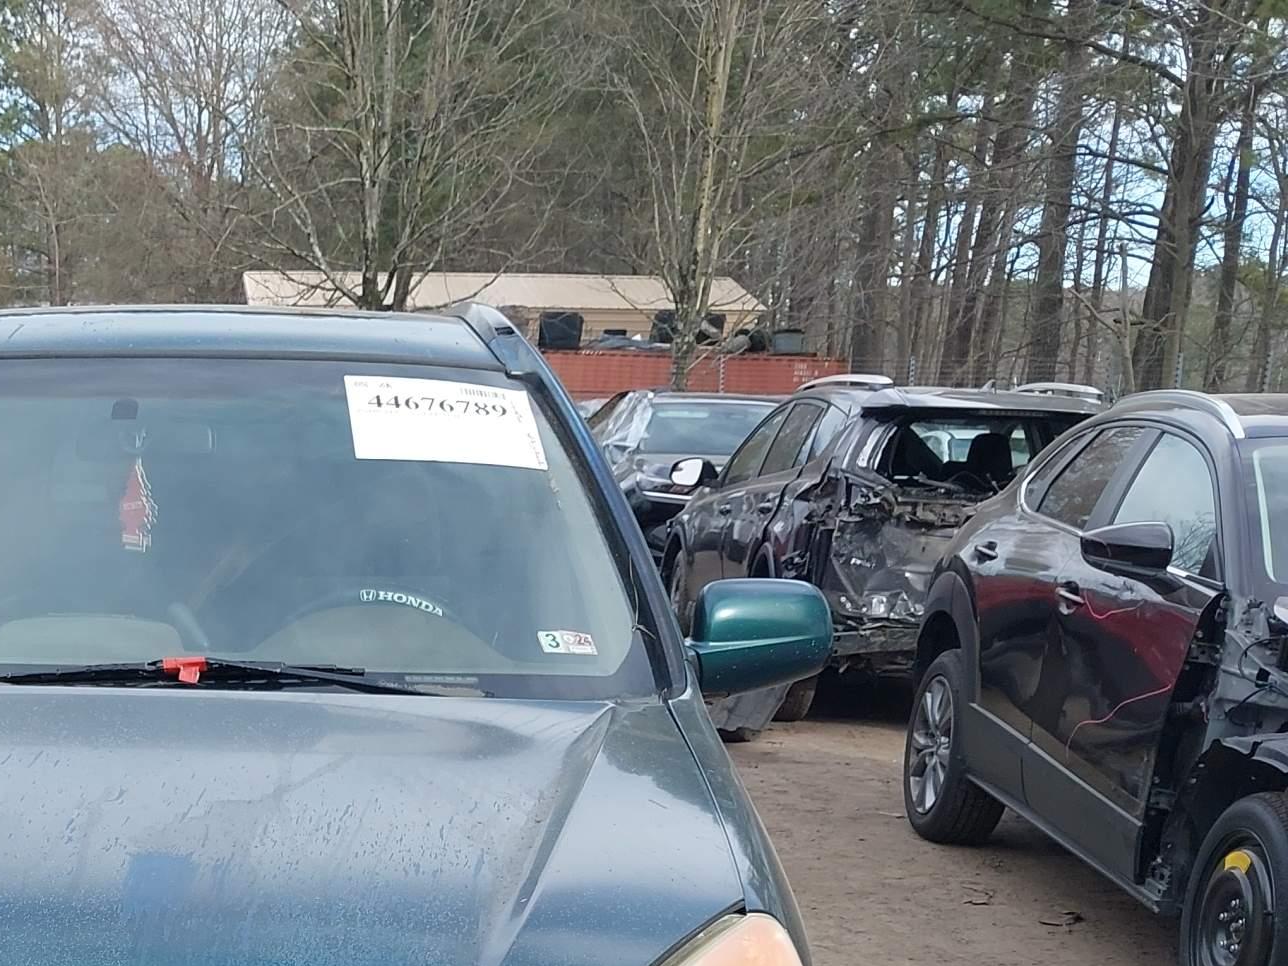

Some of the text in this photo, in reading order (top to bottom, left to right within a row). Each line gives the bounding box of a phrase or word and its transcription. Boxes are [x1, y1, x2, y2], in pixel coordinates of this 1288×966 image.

[368, 394, 507, 416] 44676789
[377, 591, 443, 616] HONDA
[545, 633, 560, 648] 3
